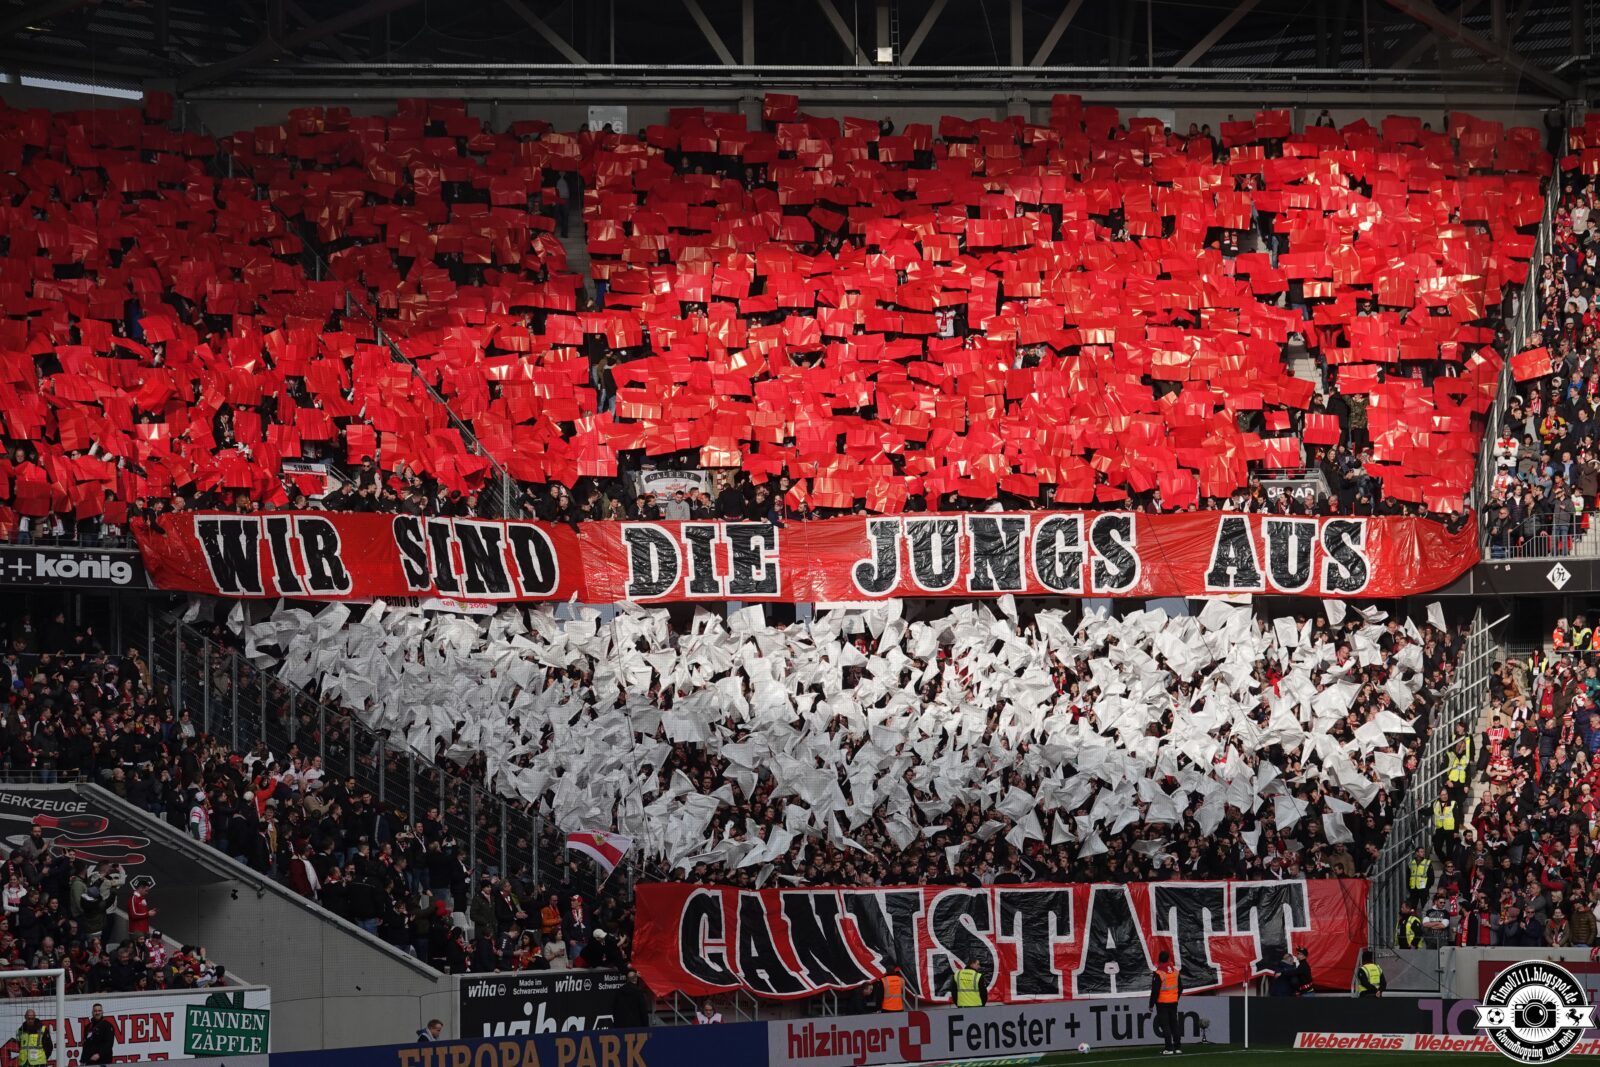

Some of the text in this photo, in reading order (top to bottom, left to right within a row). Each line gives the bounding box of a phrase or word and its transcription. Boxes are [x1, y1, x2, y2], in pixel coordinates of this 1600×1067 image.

[194, 511, 1370, 600] WIR SIND DIE JUNGS AUS
[36, 552, 133, 585] könig
[0, 791, 88, 813] ERKZEUGE
[679, 879, 1311, 1001] CANNSTATT
[468, 980, 497, 998] wiha
[513, 986, 549, 996] Schwarzwald
[555, 975, 582, 993] wiha
[598, 982, 624, 990] Schwarz
[190, 1009, 266, 1031] TANNEN
[191, 1028, 262, 1054] ZÄPFLE
[398, 1032, 652, 1067] EUROPA PARK
[787, 1022, 895, 1066] hilzinger
[948, 1011, 1056, 1052] Fenster
[1300, 1033, 1404, 1050] WeberHaus
[1414, 1034, 1499, 1052] WeberHa
